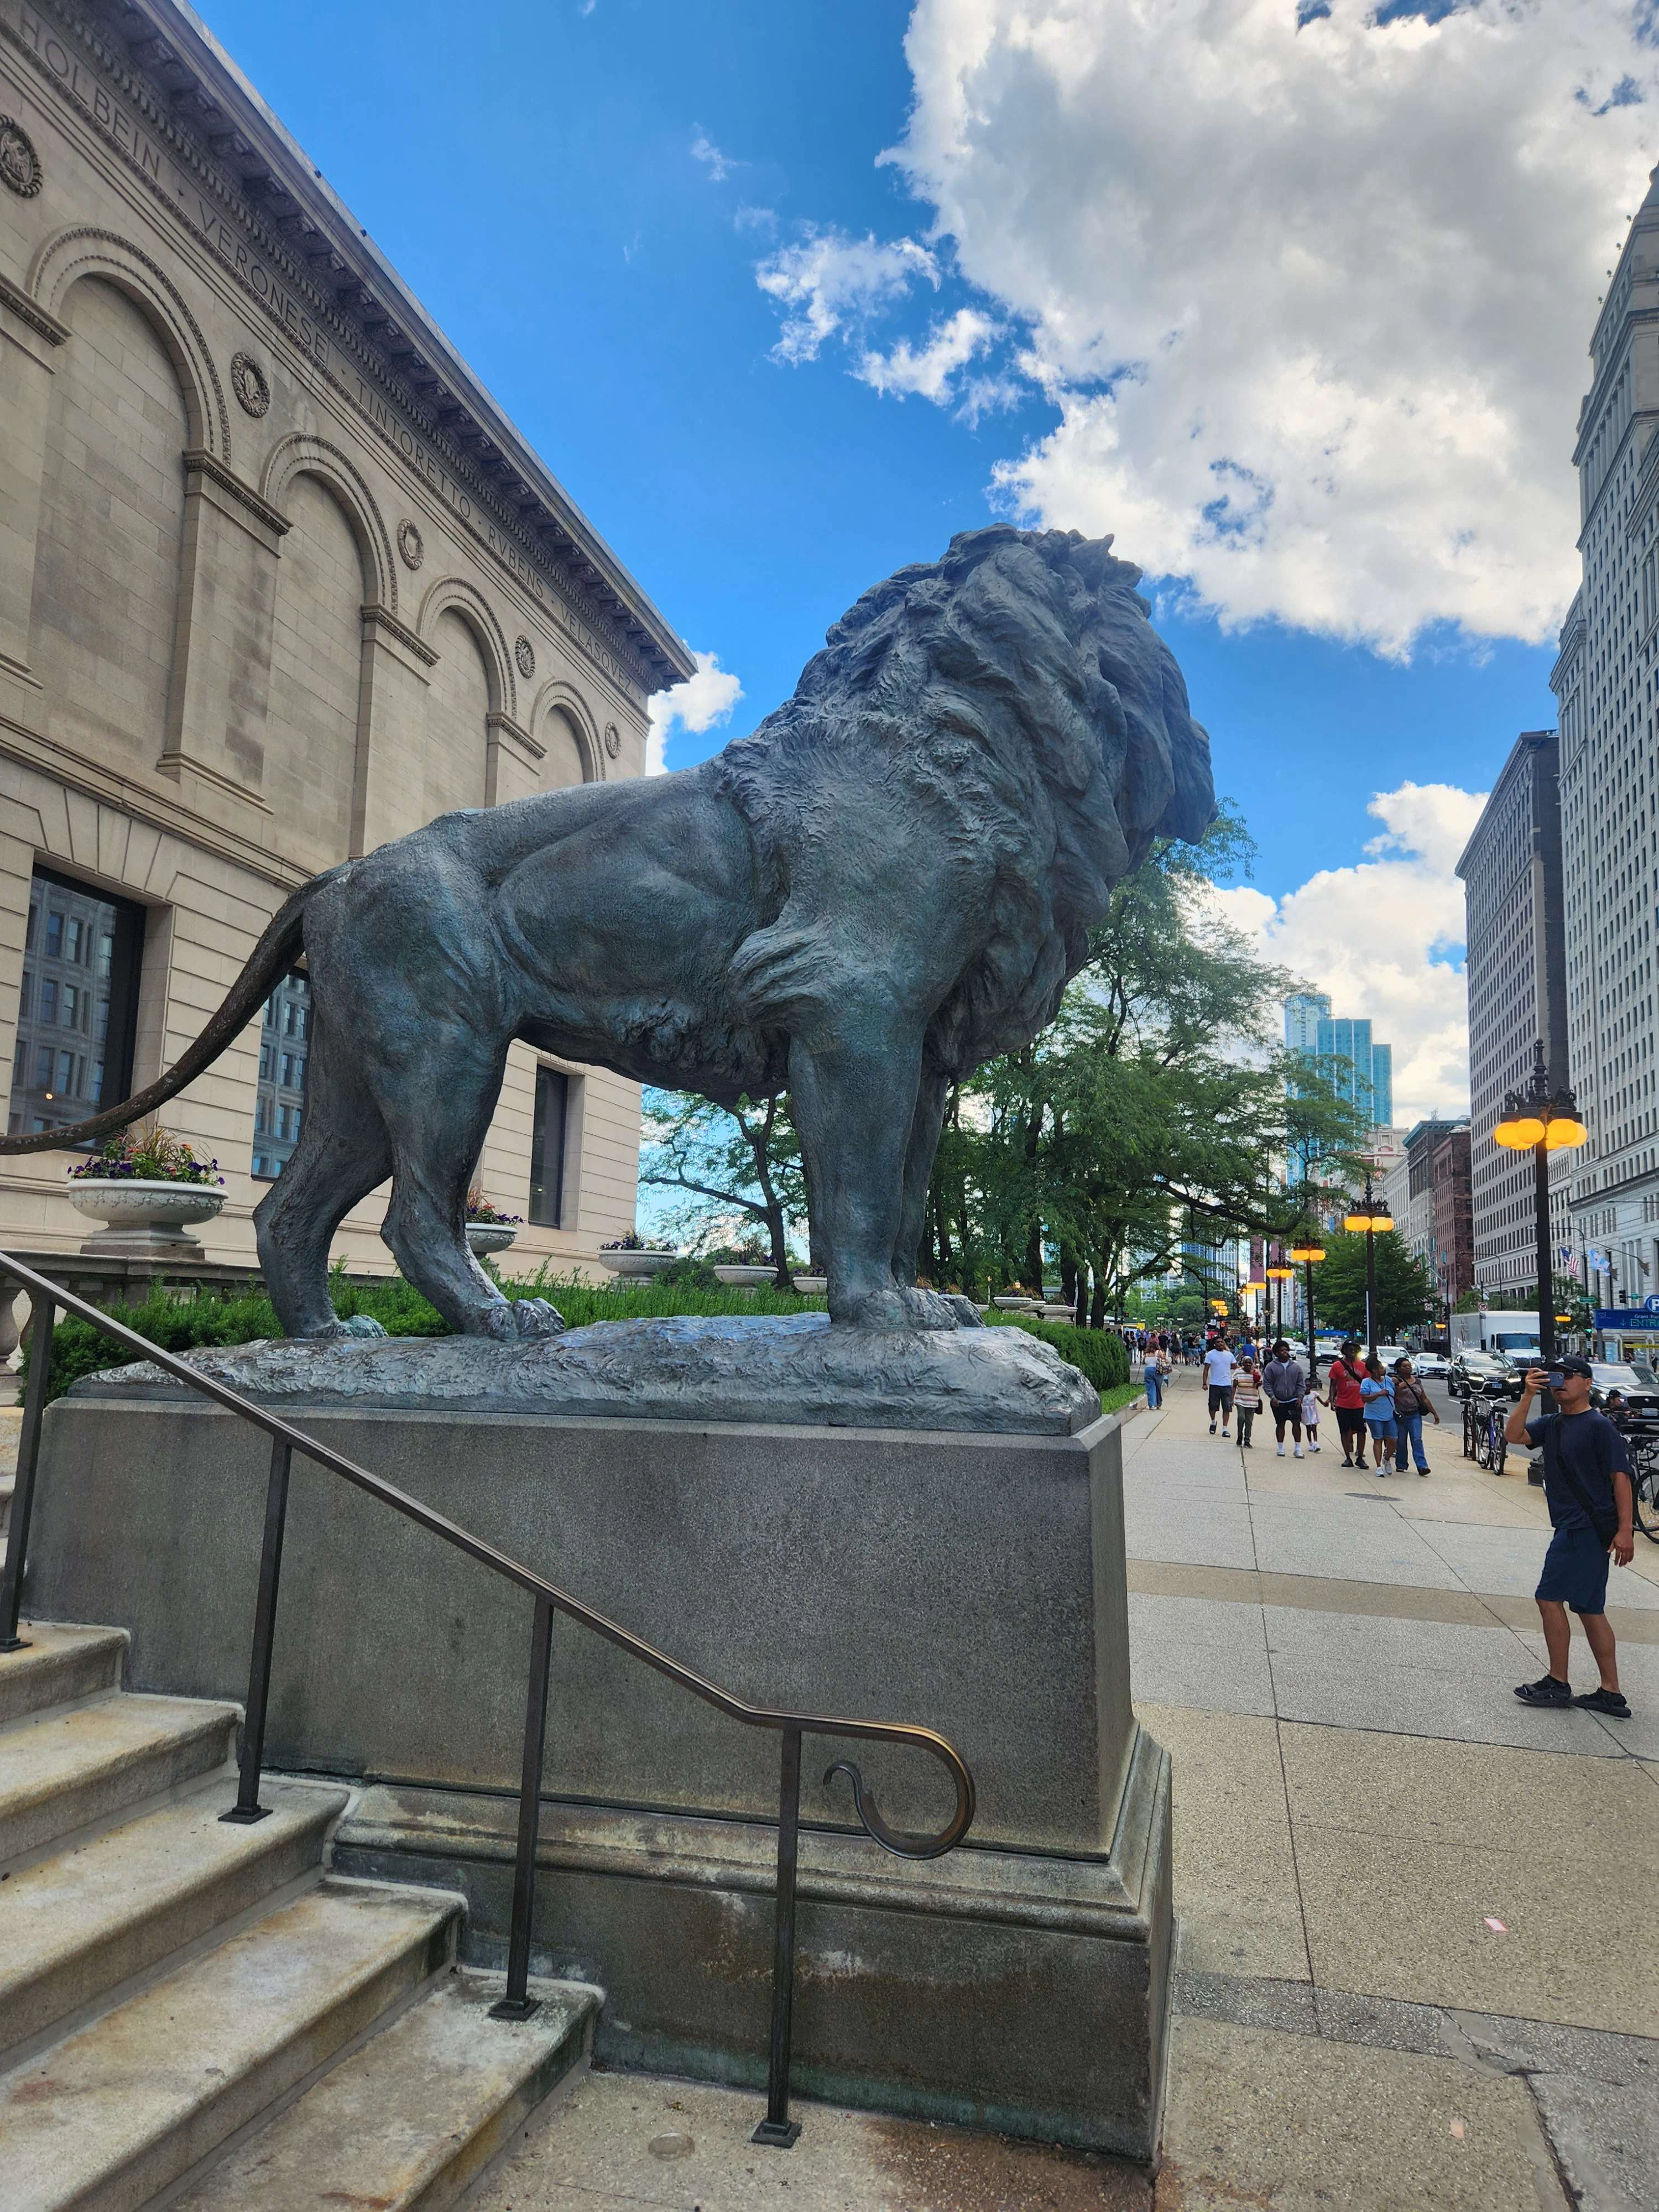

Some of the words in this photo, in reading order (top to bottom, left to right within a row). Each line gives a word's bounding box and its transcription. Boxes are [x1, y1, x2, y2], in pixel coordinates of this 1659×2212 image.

[20, 6, 159, 178] HOLBEIN
[199, 200, 328, 364] VERONESE
[356, 378, 471, 518] TINTORETTO
[489, 526, 544, 598] RVBENS
[561, 604, 633, 695] VELASQVEZ
